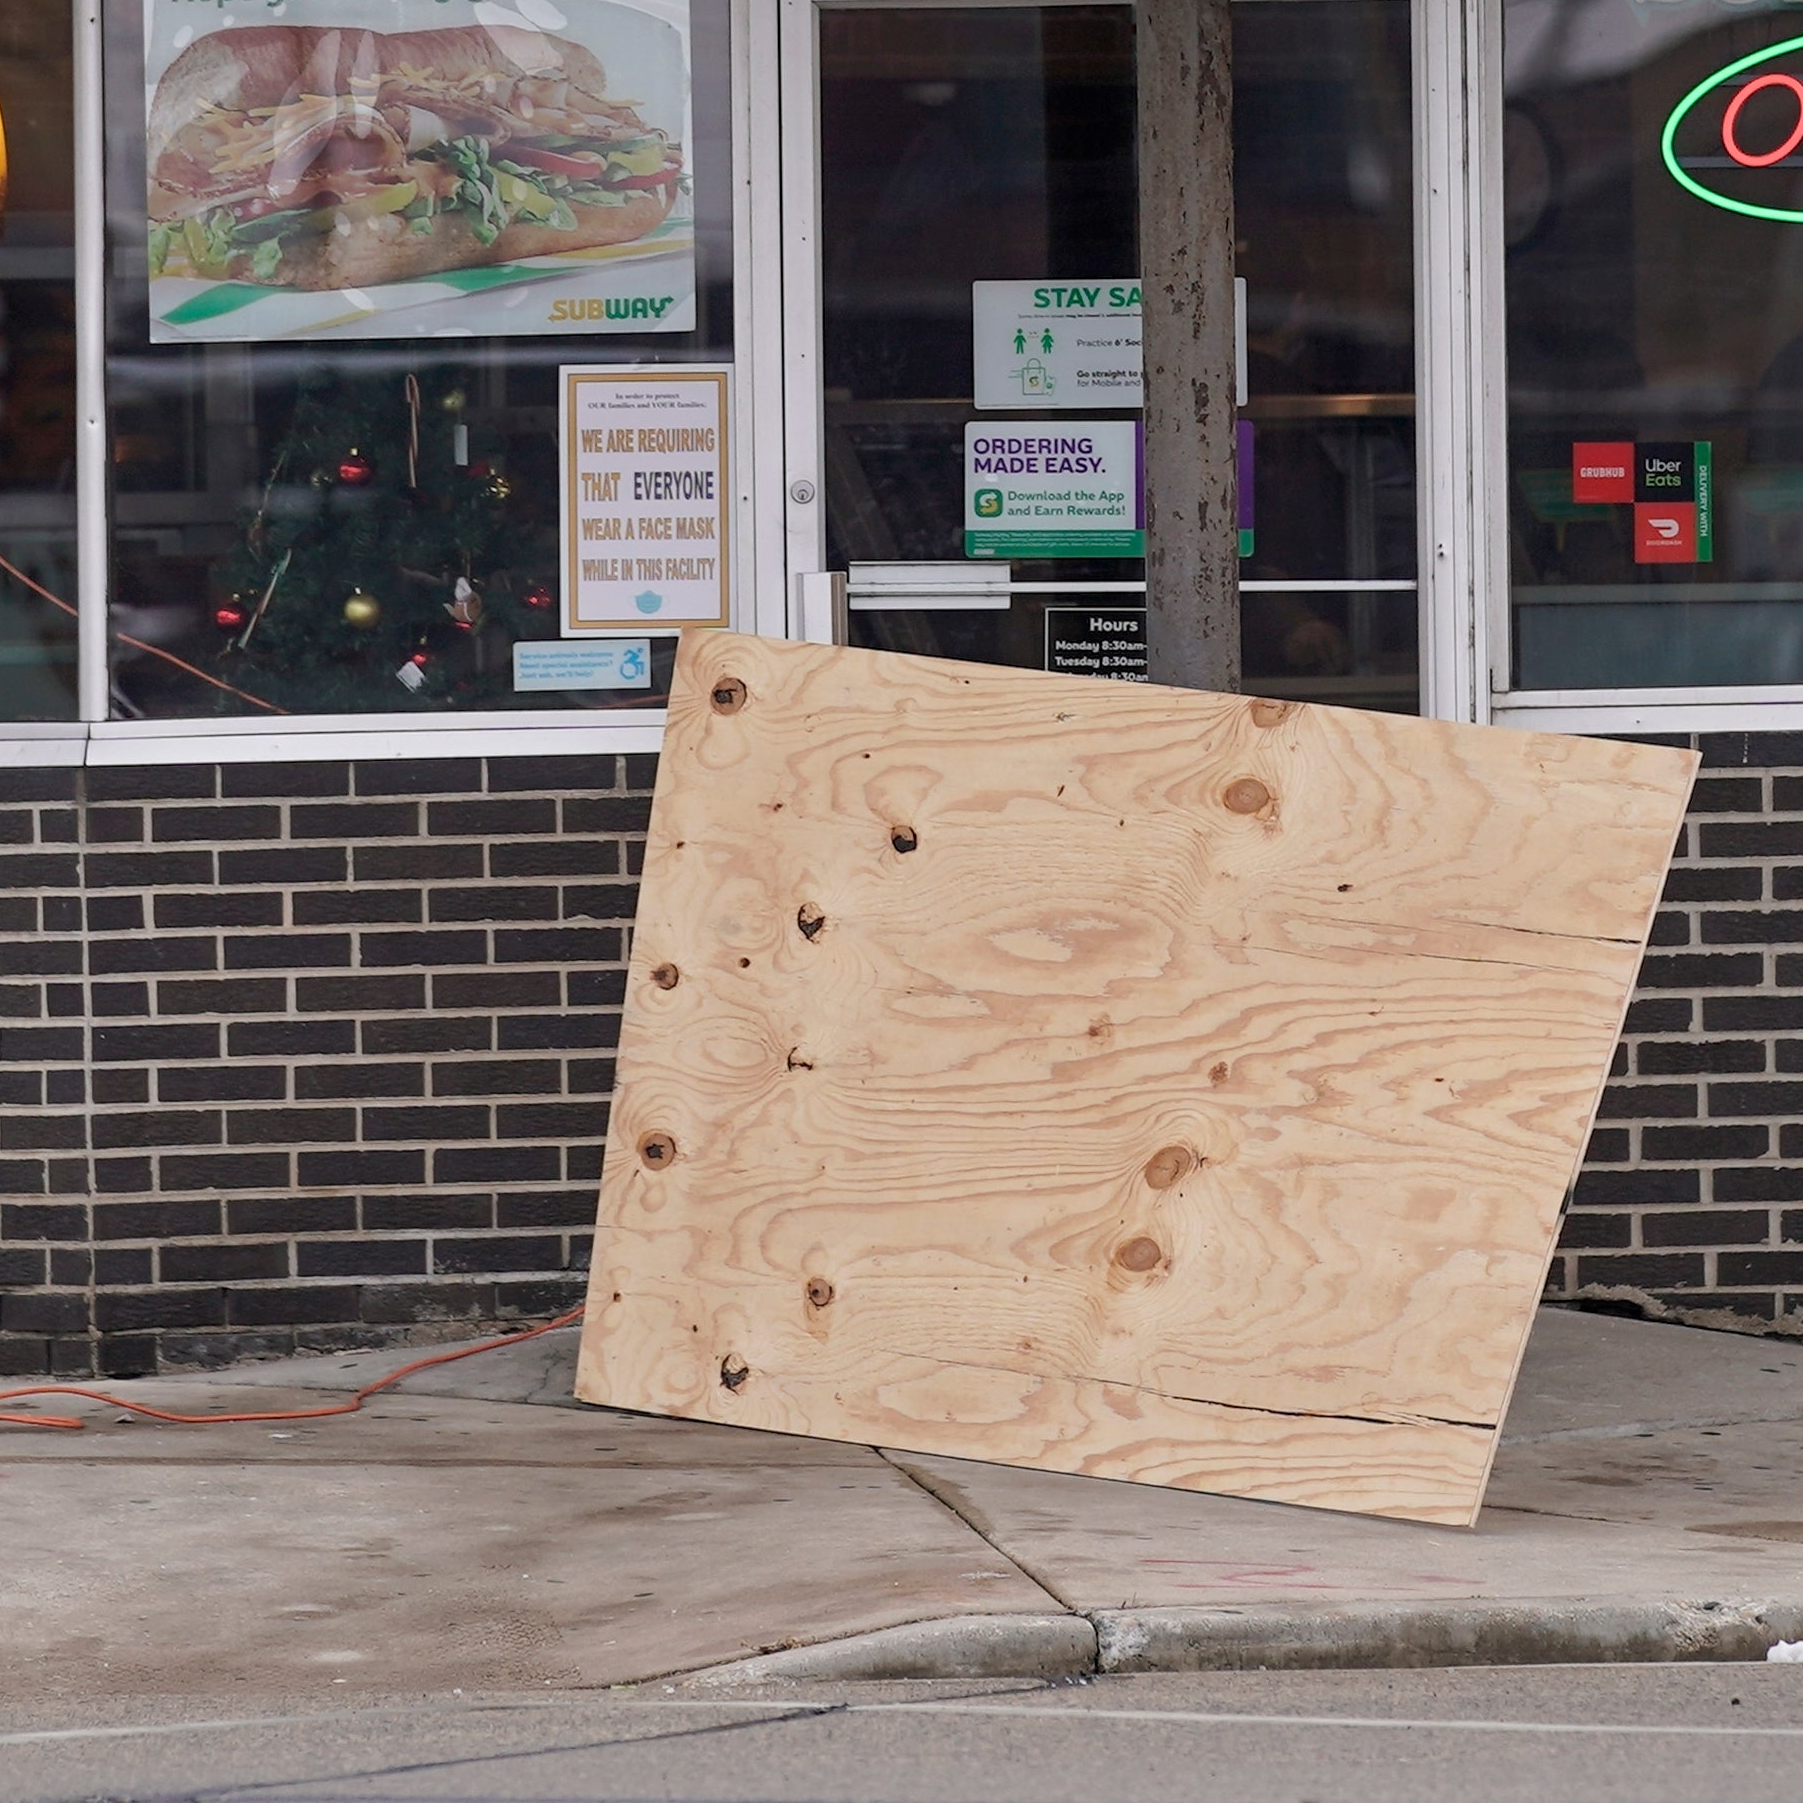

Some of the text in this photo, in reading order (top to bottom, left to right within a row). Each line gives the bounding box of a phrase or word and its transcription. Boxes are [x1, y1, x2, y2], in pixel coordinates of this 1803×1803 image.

[1033, 287, 1100, 308] STAY
[548, 296, 674, 323] SUBWAY
[1077, 339, 1112, 347] Practice
[1092, 369, 1126, 379] straight
[1077, 379, 1141, 387] for Mobile and
[581, 428, 715, 454] WE ARE REQUIRING
[973, 438, 1093, 454] ORDERING
[974, 457, 1106, 473] MADE EASY.
[1645, 459, 1681, 472] Uber
[1580, 467, 1625, 478] GRUBHUB
[581, 471, 714, 501] THAT EVERYONE
[1645, 473, 1681, 486] Eats
[1007, 490, 1125, 503] Download the App
[1699, 465, 1708, 536] DELIVERY WITH
[1007, 505, 1126, 516] and Earn Rewards!
[581, 517, 715, 540] WEAR A FACE MASK
[581, 558, 715, 581] WHILE IN THIS FACILITY
[1089, 617, 1139, 631] Hours
[1055, 640, 1099, 653] Monday
[1054, 656, 1100, 668] Tuesday
